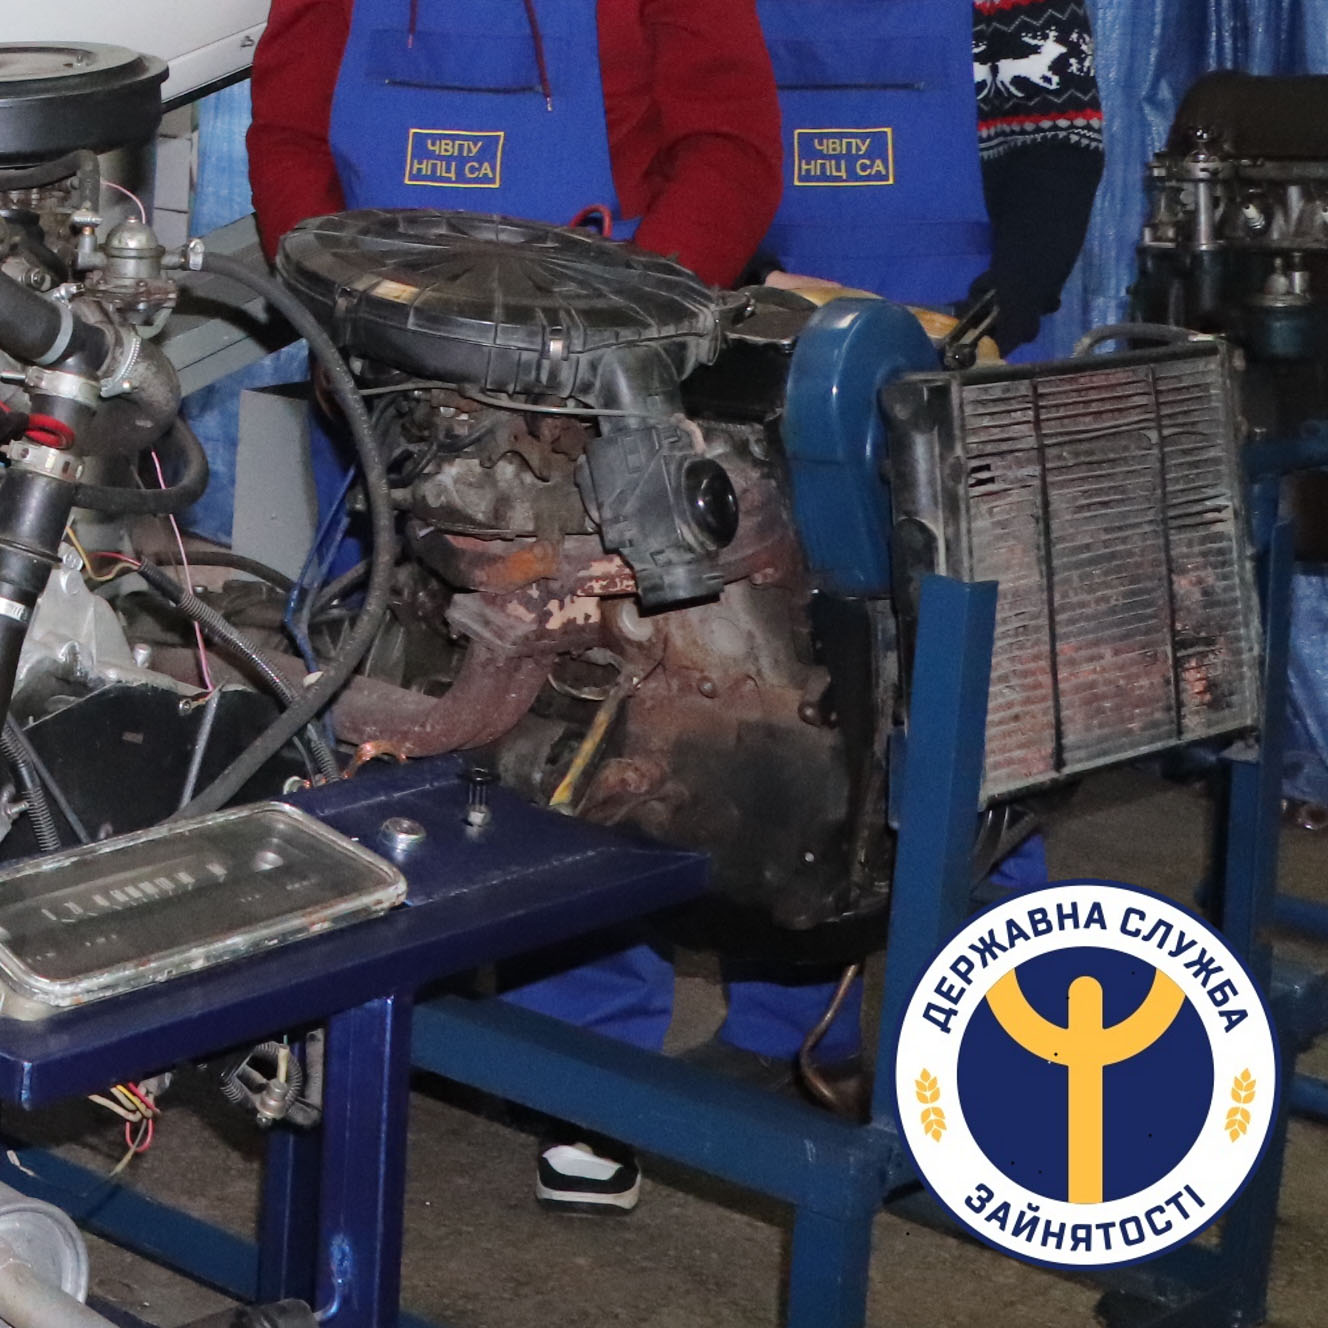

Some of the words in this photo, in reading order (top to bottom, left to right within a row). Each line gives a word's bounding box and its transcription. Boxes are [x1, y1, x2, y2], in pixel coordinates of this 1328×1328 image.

[427, 139, 483, 156] ЧВПУ
[814, 138, 872, 155] ЧВПУ
[412, 159, 456, 181] НПЦ
[465, 161, 494, 178] СА
[801, 159, 847, 180] НПЦ
[856, 159, 887, 176] СА
